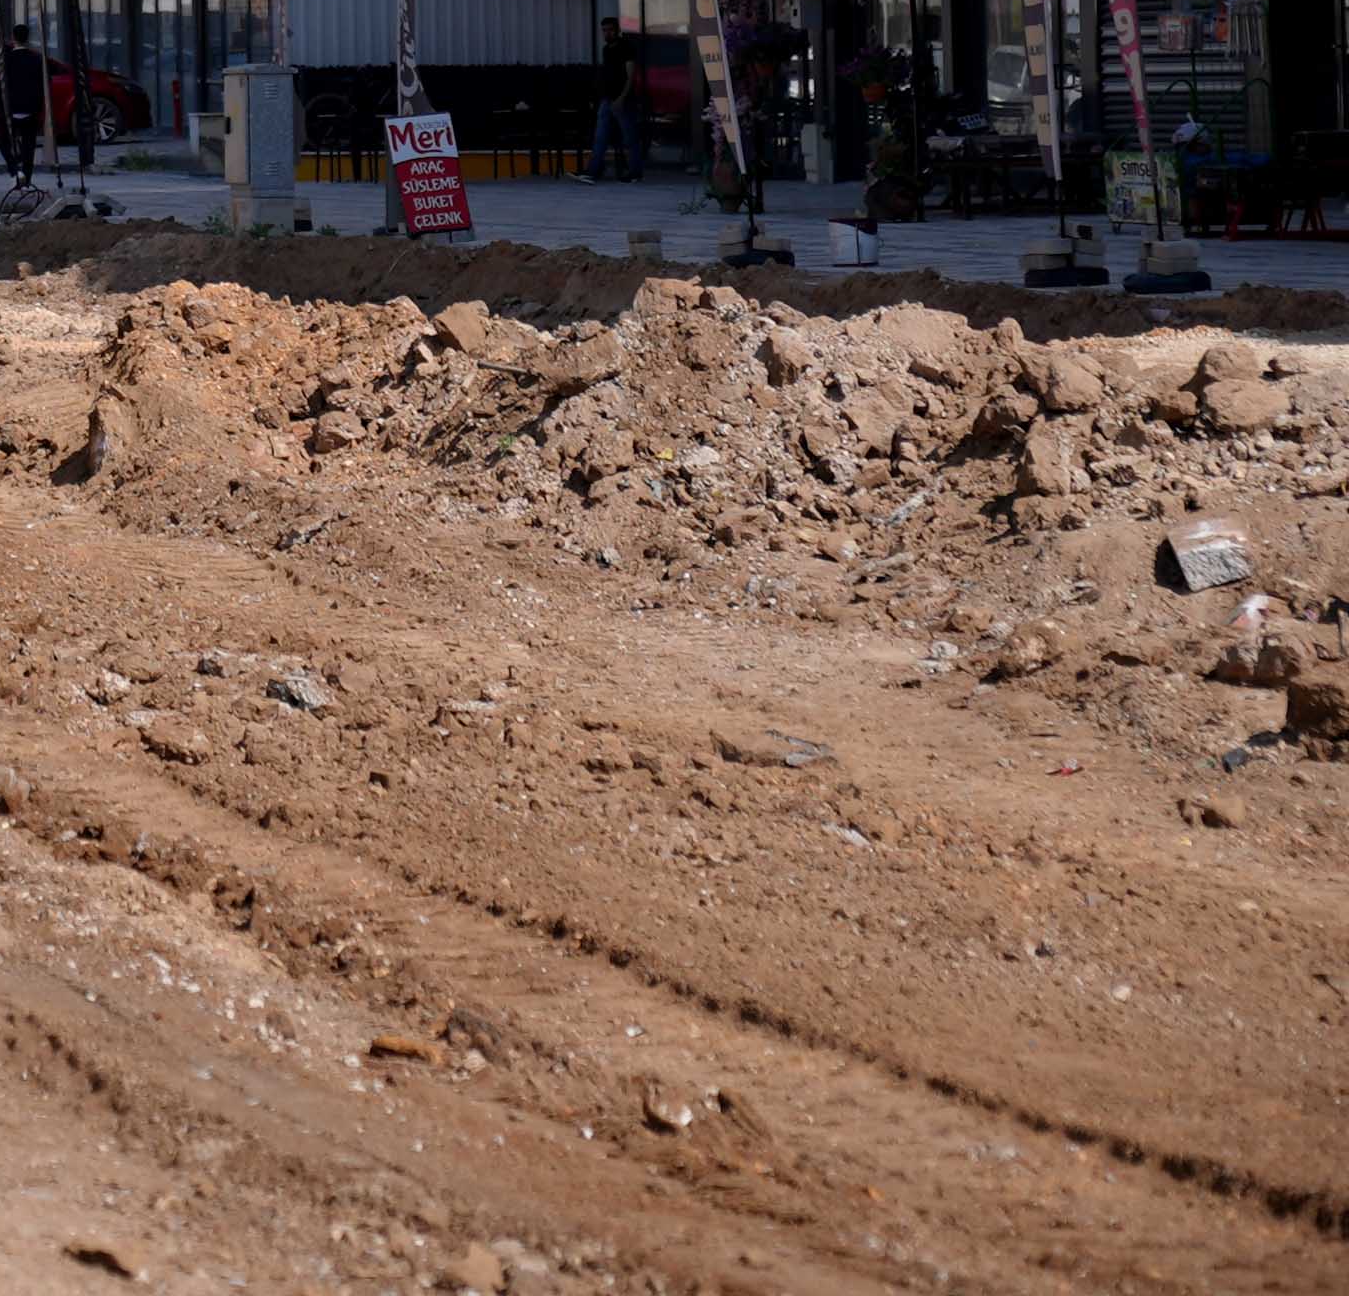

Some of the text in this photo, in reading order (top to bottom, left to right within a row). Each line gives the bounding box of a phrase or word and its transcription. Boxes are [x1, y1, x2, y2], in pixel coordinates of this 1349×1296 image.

[389, 122, 453, 154] Meri
[410, 160, 446, 176] ARAÇ
[403, 176, 460, 195] SÜSLEME
[413, 195, 454, 211] BUKET
[414, 211, 463, 229] ÇELENK
